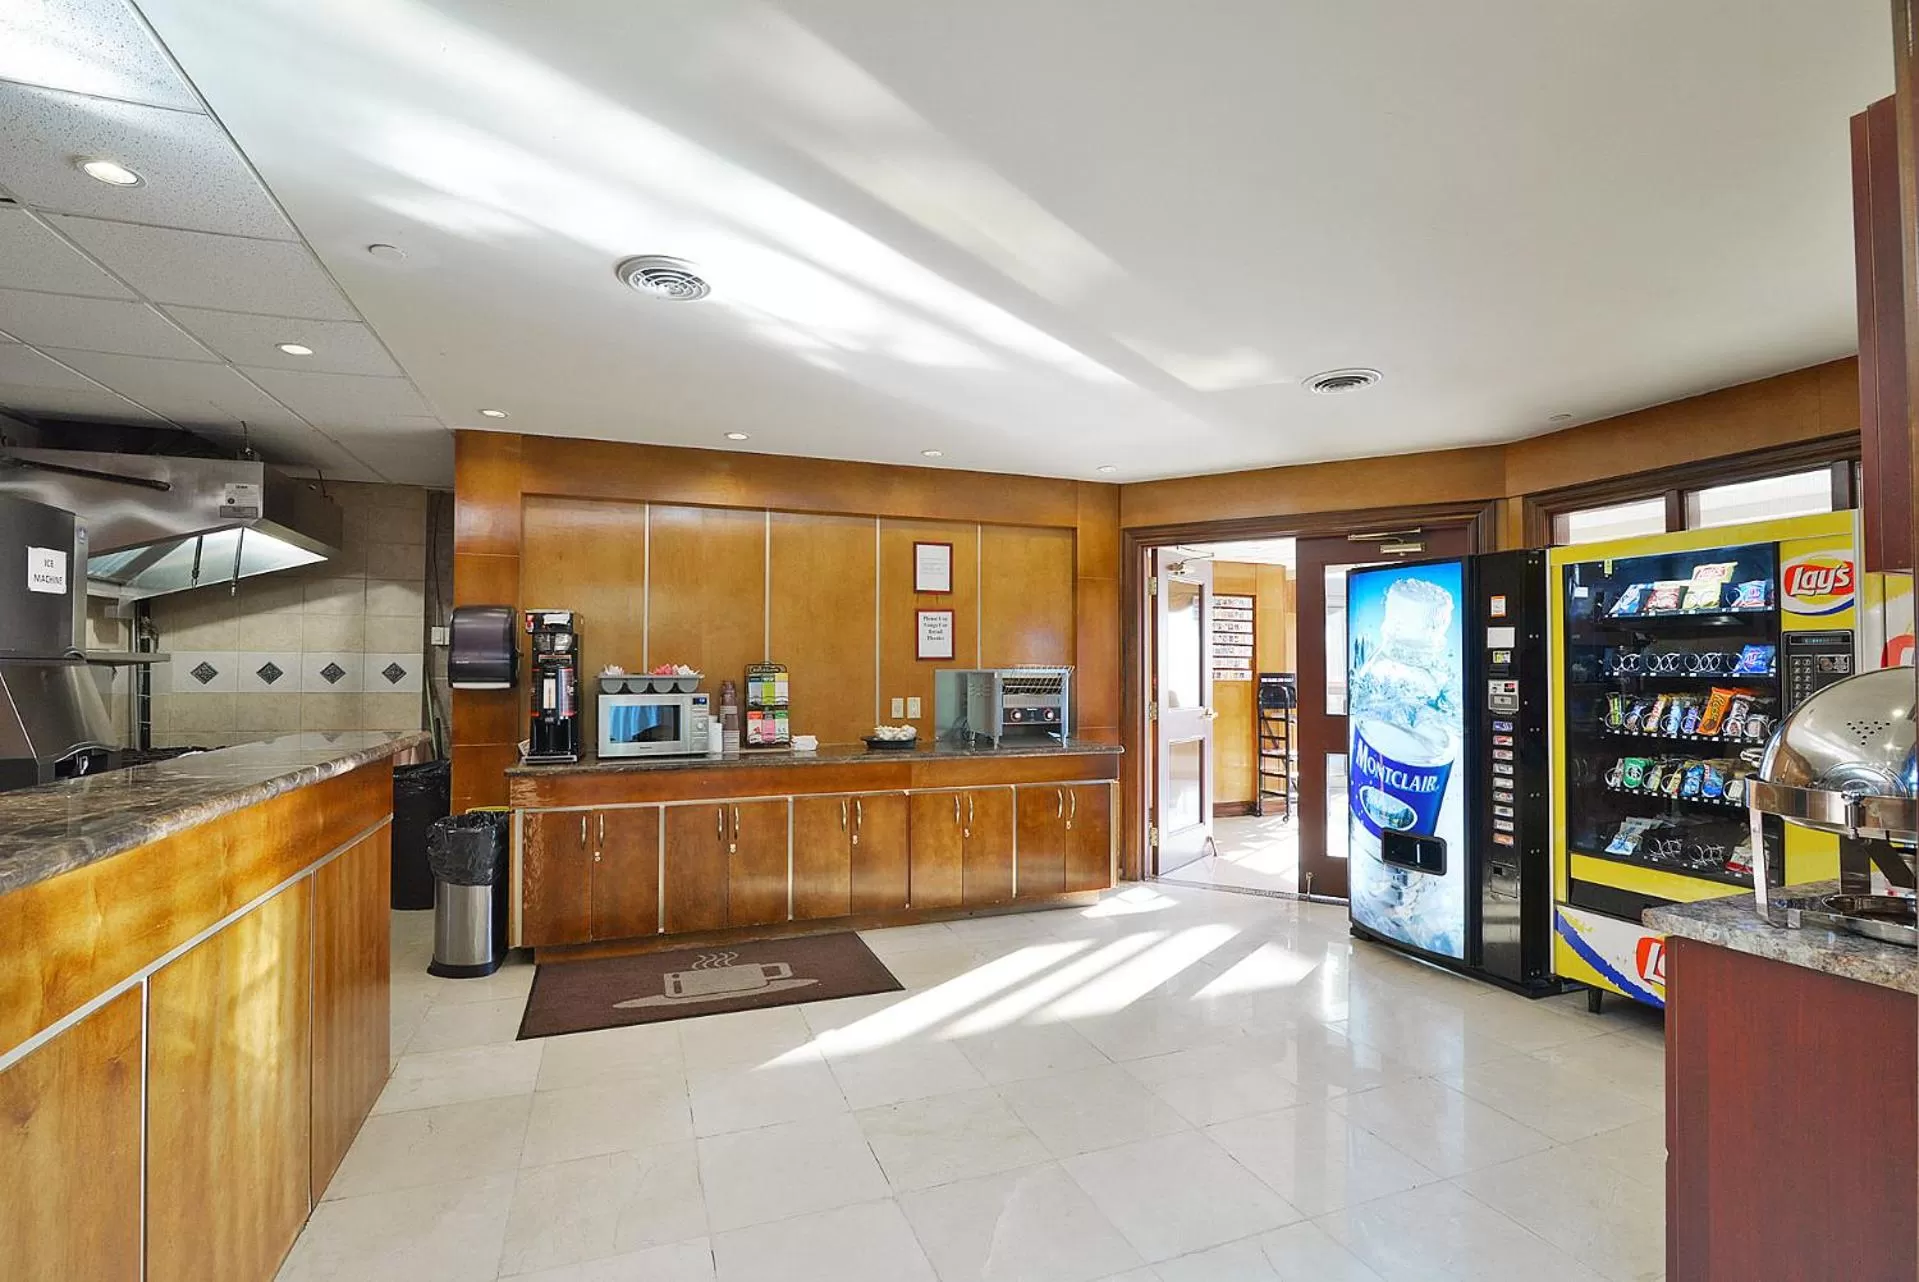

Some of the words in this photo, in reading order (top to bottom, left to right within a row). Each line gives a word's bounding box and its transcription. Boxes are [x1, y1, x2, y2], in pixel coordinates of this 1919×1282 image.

[44, 559, 54, 568] ICE
[33, 573, 63, 585] MACHINE
[1790, 564, 1851, 596] Lay's
[1356, 738, 1439, 792] MONTCLAIR
